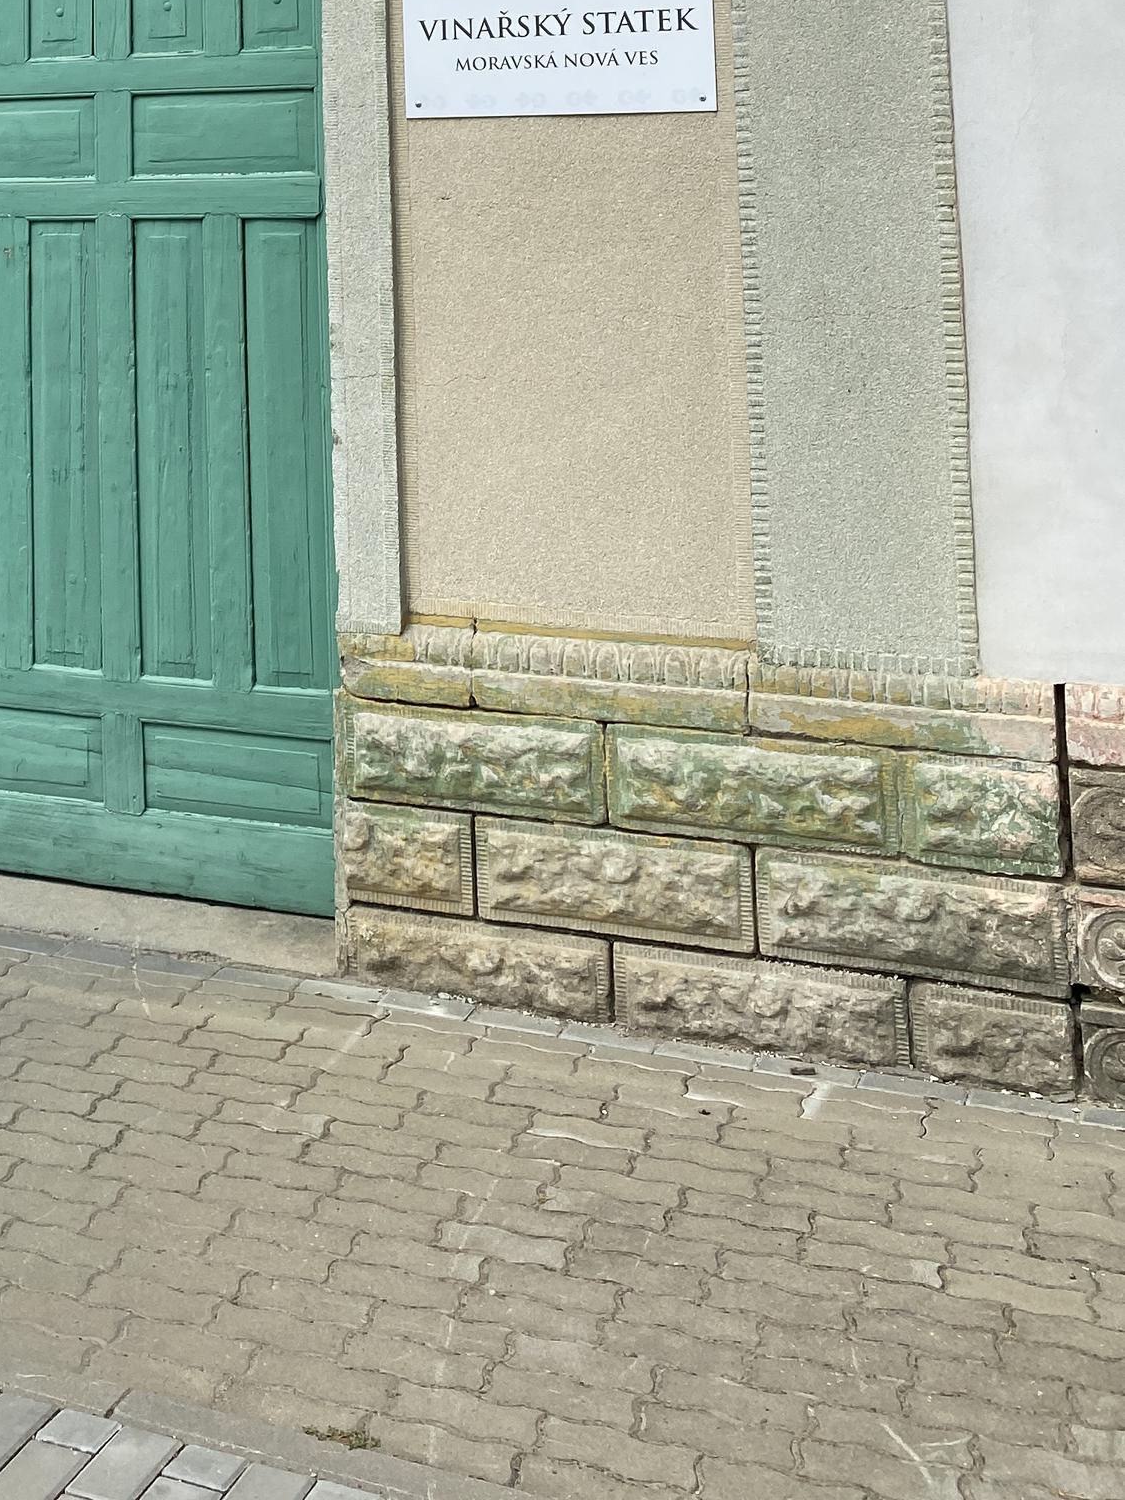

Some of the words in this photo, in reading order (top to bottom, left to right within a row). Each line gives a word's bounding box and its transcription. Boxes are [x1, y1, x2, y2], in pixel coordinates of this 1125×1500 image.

[418, 7, 573, 41] VINAŘSKÝ
[582, 7, 699, 35] STATEK
[454, 50, 558, 72] MORAVSKÁ
[564, 48, 619, 68] NOVÁ
[625, 50, 659, 66] VES
